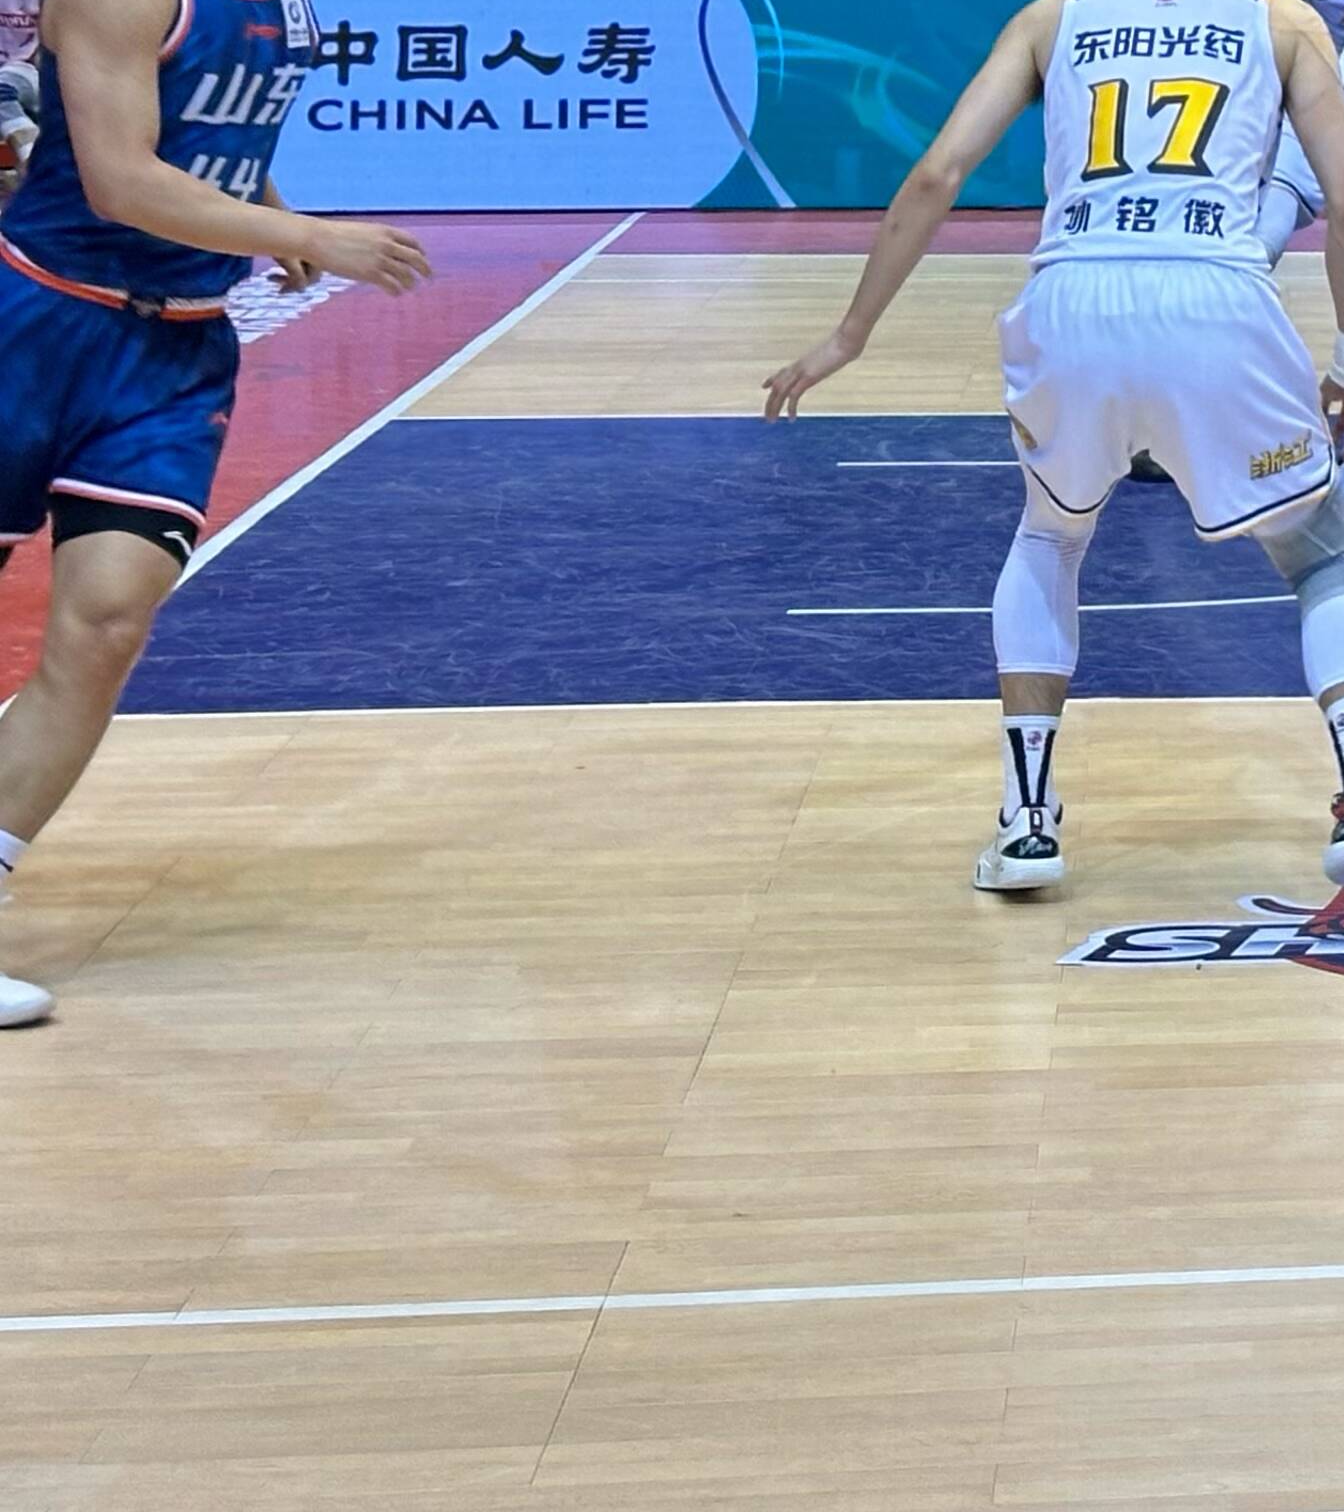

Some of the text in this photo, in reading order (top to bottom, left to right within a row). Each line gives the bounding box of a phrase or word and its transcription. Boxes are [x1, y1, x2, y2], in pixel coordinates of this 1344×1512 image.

[312, 20, 656, 86] 中国人寿
[1073, 24, 1246, 67] 东阳光药
[180, 63, 306, 125] 山东
[307, 99, 649, 131] CHINA LIFE
[1080, 77, 1231, 182] 17
